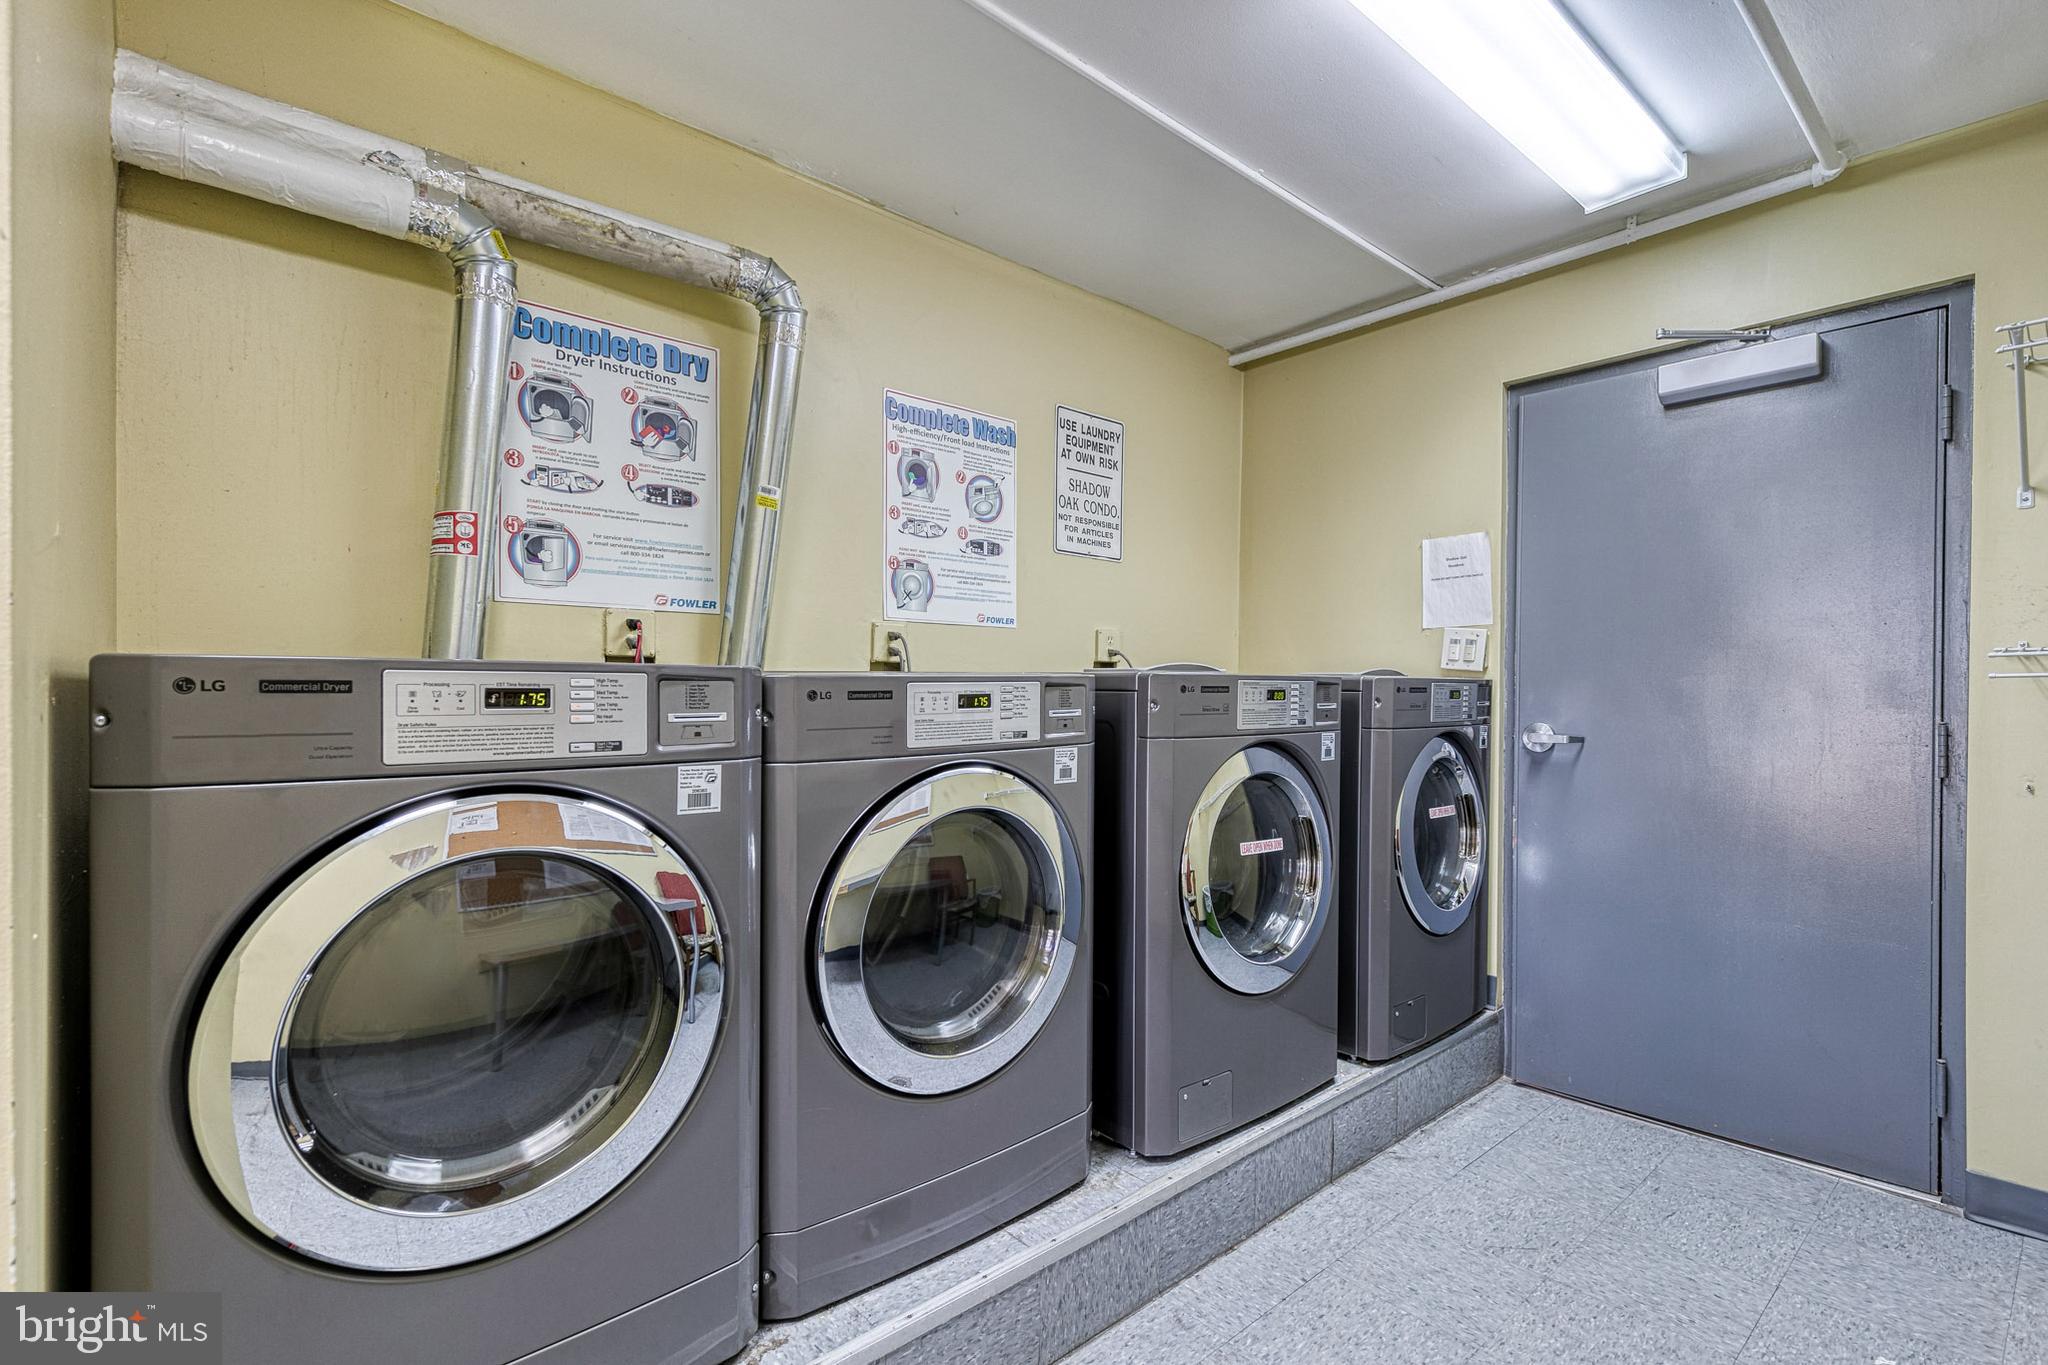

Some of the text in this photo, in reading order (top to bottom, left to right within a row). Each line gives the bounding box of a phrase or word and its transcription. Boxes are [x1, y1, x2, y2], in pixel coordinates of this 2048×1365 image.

[513, 306, 710, 383] Complete Dry
[555, 349, 595, 368] Dryer
[599, 358, 678, 386] Instructions
[885, 396, 970, 437] Complete
[971, 417, 1017, 449] Wash
[1059, 417, 1121, 443] USE LAUNDRY
[892, 423, 960, 446] High-efficiency/Front
[962, 439, 975, 448] load
[976, 441, 1010, 456] Instructions
[1066, 434, 1115, 456] EQUIPMENT
[1061, 448, 1119, 471] AT OWN RISK
[1068, 478, 1111, 499] SHADOW
[1059, 494, 1120, 519] OAK CONDO.
[1058, 513, 1120, 531] NOT RESPONSIBLE
[1064, 525, 1114, 539] FOR ARTICLES
[1067, 534, 1112, 549] IN MACHINES
[670, 598, 717, 609] FOWLER
[986, 616, 1015, 625] FOWLER
[201, 679, 226, 692] LG
[261, 681, 350, 693] Commercial Dryer
[520, 693, 546, 706] 1.75
[819, 691, 832, 700] LG
[974, 696, 988, 708] 1.75
